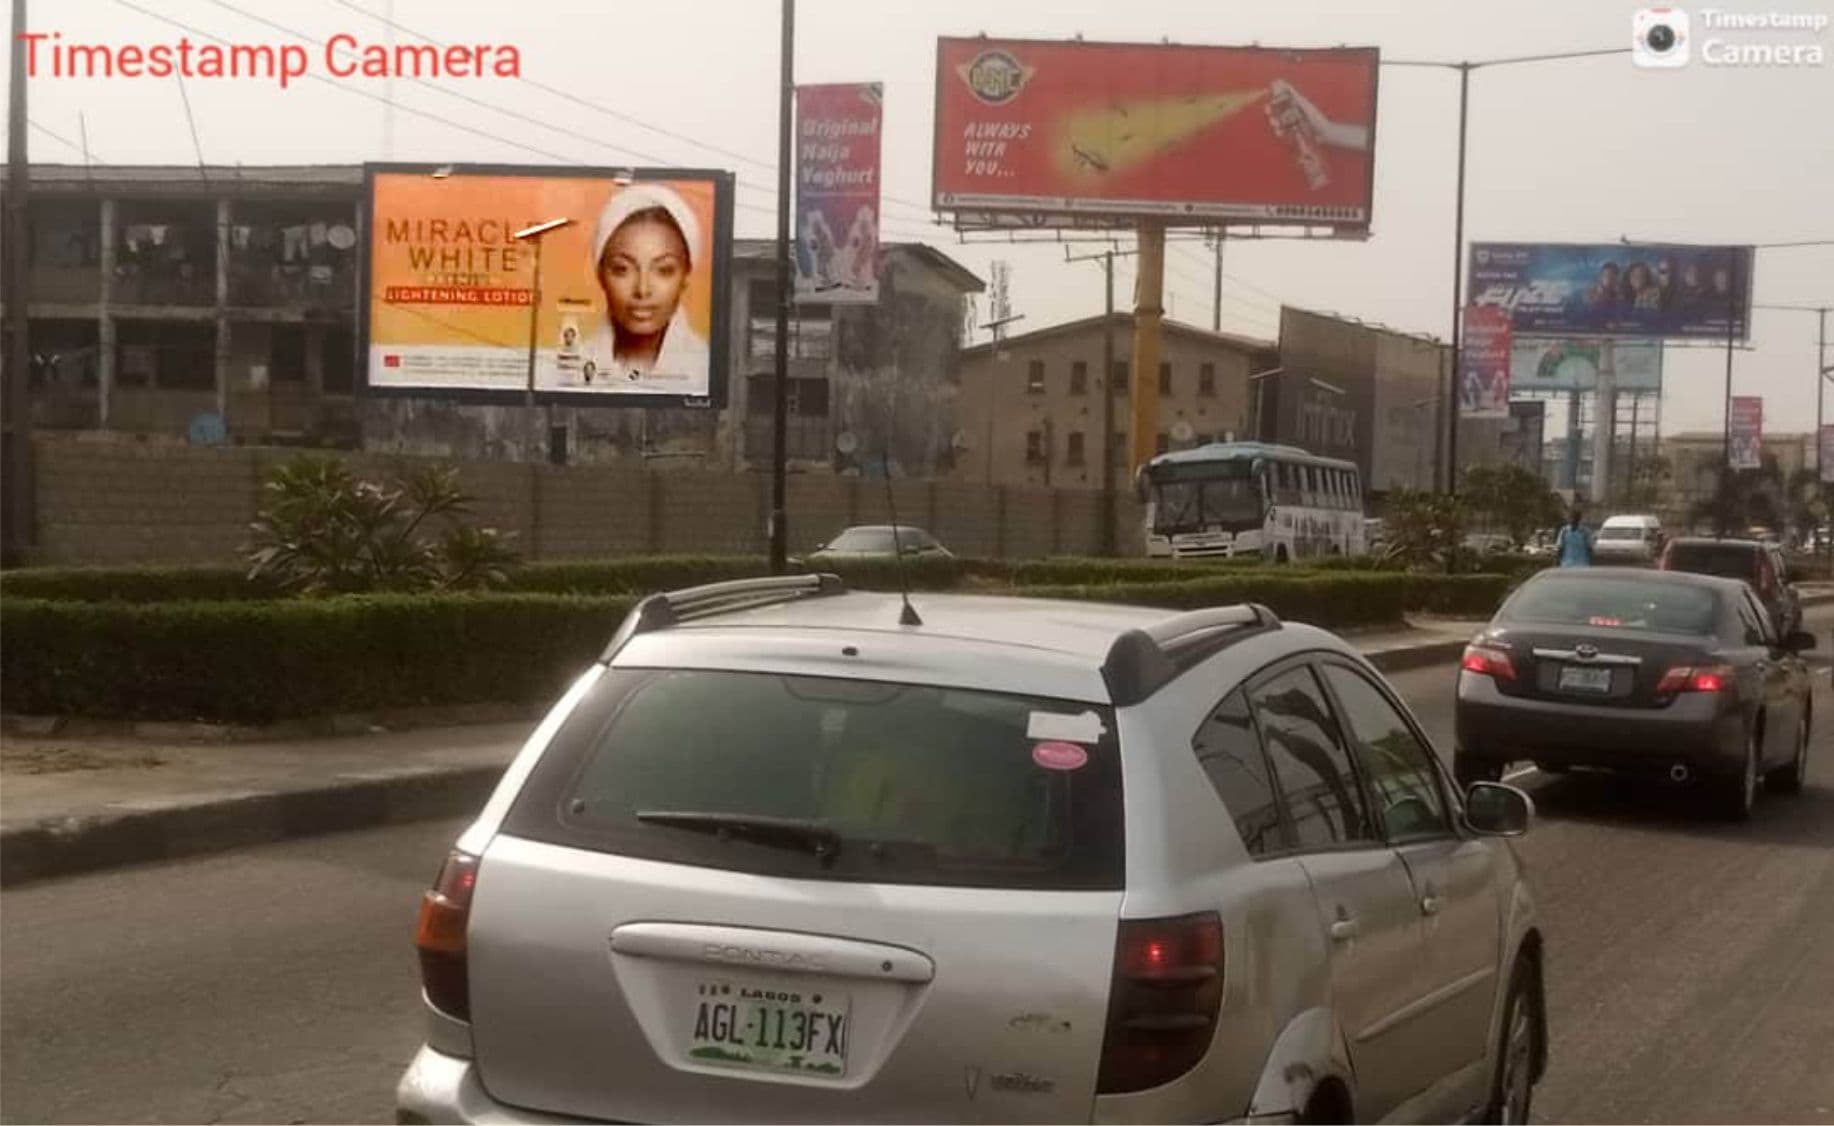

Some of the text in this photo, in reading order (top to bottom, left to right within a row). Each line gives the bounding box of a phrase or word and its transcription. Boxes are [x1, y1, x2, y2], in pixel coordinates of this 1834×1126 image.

[803, 118, 878, 139] Original
[964, 122, 1031, 140] ALWAYS
[802, 144, 850, 164] Naija
[801, 168, 873, 188] Yoghurt
[409, 246, 519, 272] WHITE
[387, 288, 476, 303] LIGHTENING
[741, 988, 803, 1003] LAGOS
